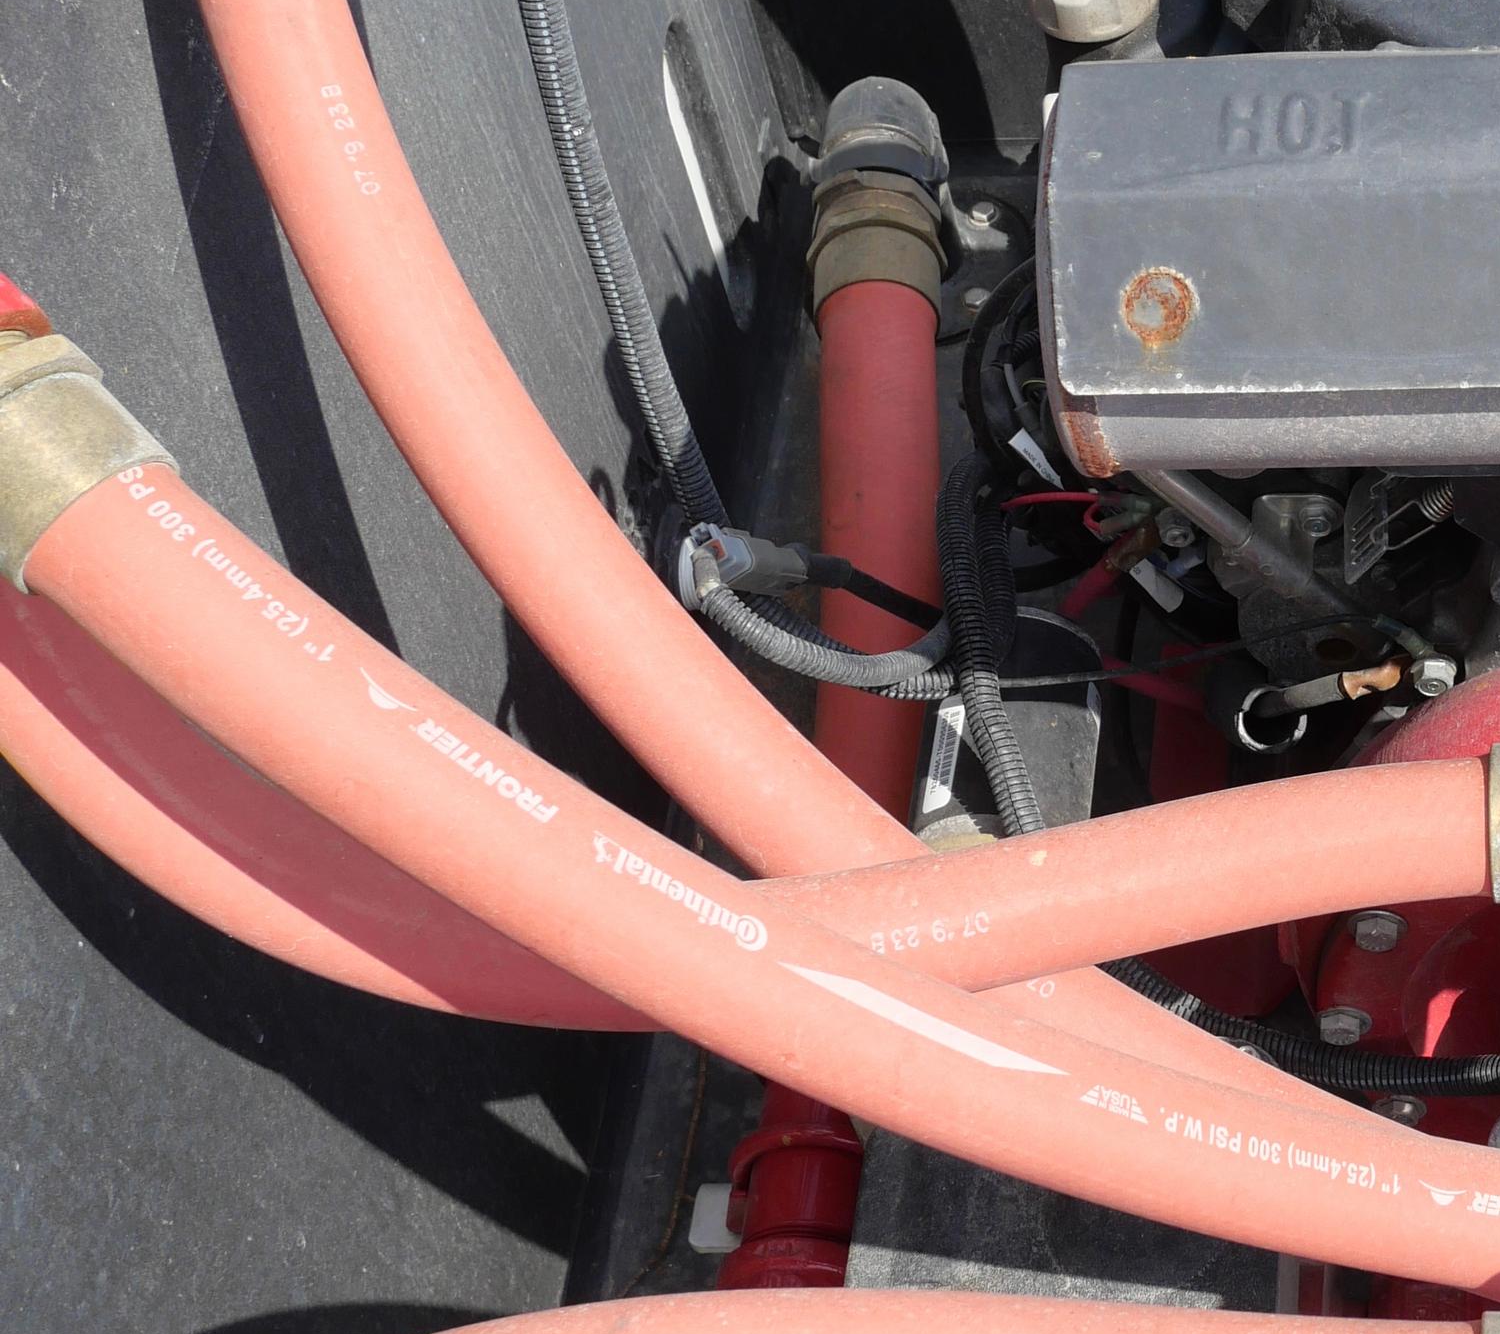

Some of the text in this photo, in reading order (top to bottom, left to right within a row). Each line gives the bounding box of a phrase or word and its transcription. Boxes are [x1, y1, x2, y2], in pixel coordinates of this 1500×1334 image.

[328, 103, 354, 130] 23
[1217, 89, 1362, 157] HOT
[353, 171, 380, 195] 07
[148, 501, 195, 541] 300
[192, 539, 309, 637] (25.4mm)
[413, 719, 559, 822] FRONTIER
[613, 847, 768, 951] Continental
[891, 925, 919, 950] 23
[963, 911, 991, 937] 07
[1098, 1086, 1133, 1109] USA
[1160, 1108, 1401, 1195] 1" (25.4mm) 300 PSI W.P.
